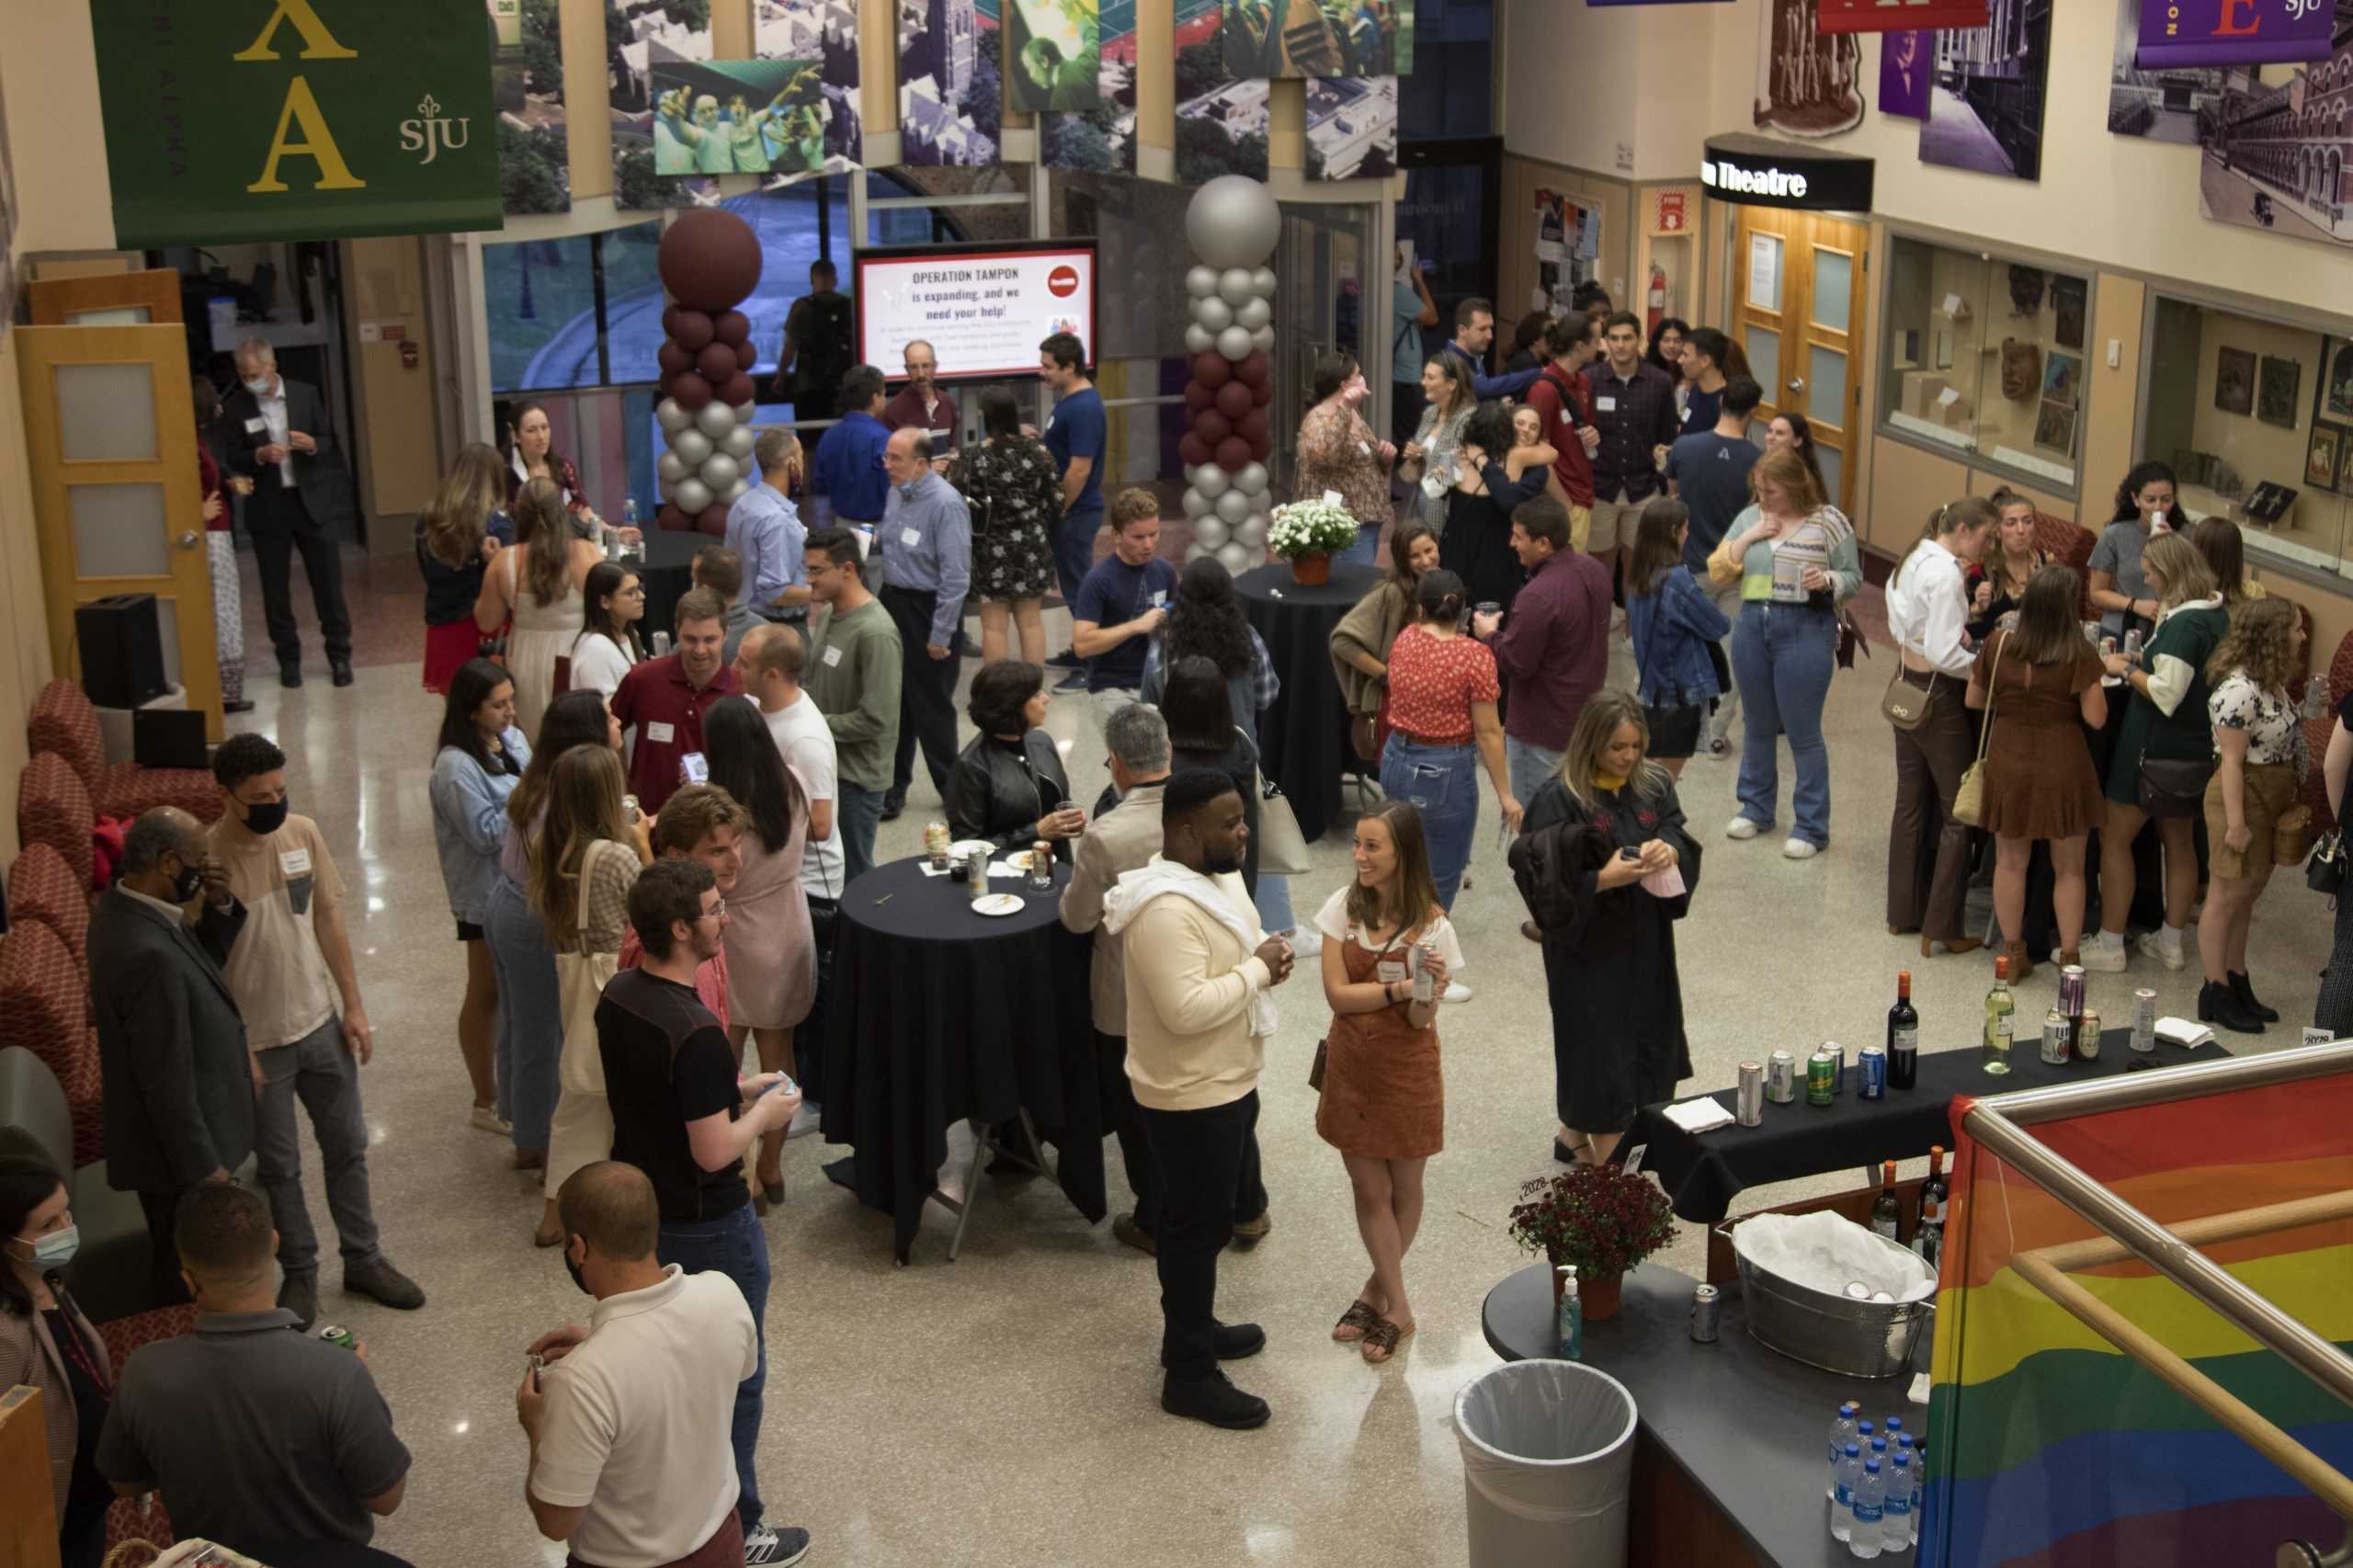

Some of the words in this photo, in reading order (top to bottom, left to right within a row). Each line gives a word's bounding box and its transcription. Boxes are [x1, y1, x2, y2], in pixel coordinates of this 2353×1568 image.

[2165, 0, 2179, 35] ON
[246, 75, 366, 192] A
[399, 118, 470, 165] SJU
[1718, 162, 1807, 198] Theatre
[913, 270, 972, 284] OPERATION
[975, 268, 1019, 280] TAMPON
[912, 291, 921, 302] is
[984, 287, 1003, 299] and
[1006, 288, 1019, 298] we
[926, 309, 950, 320] need
[955, 309, 977, 320] your
[981, 304, 1006, 318] help!
